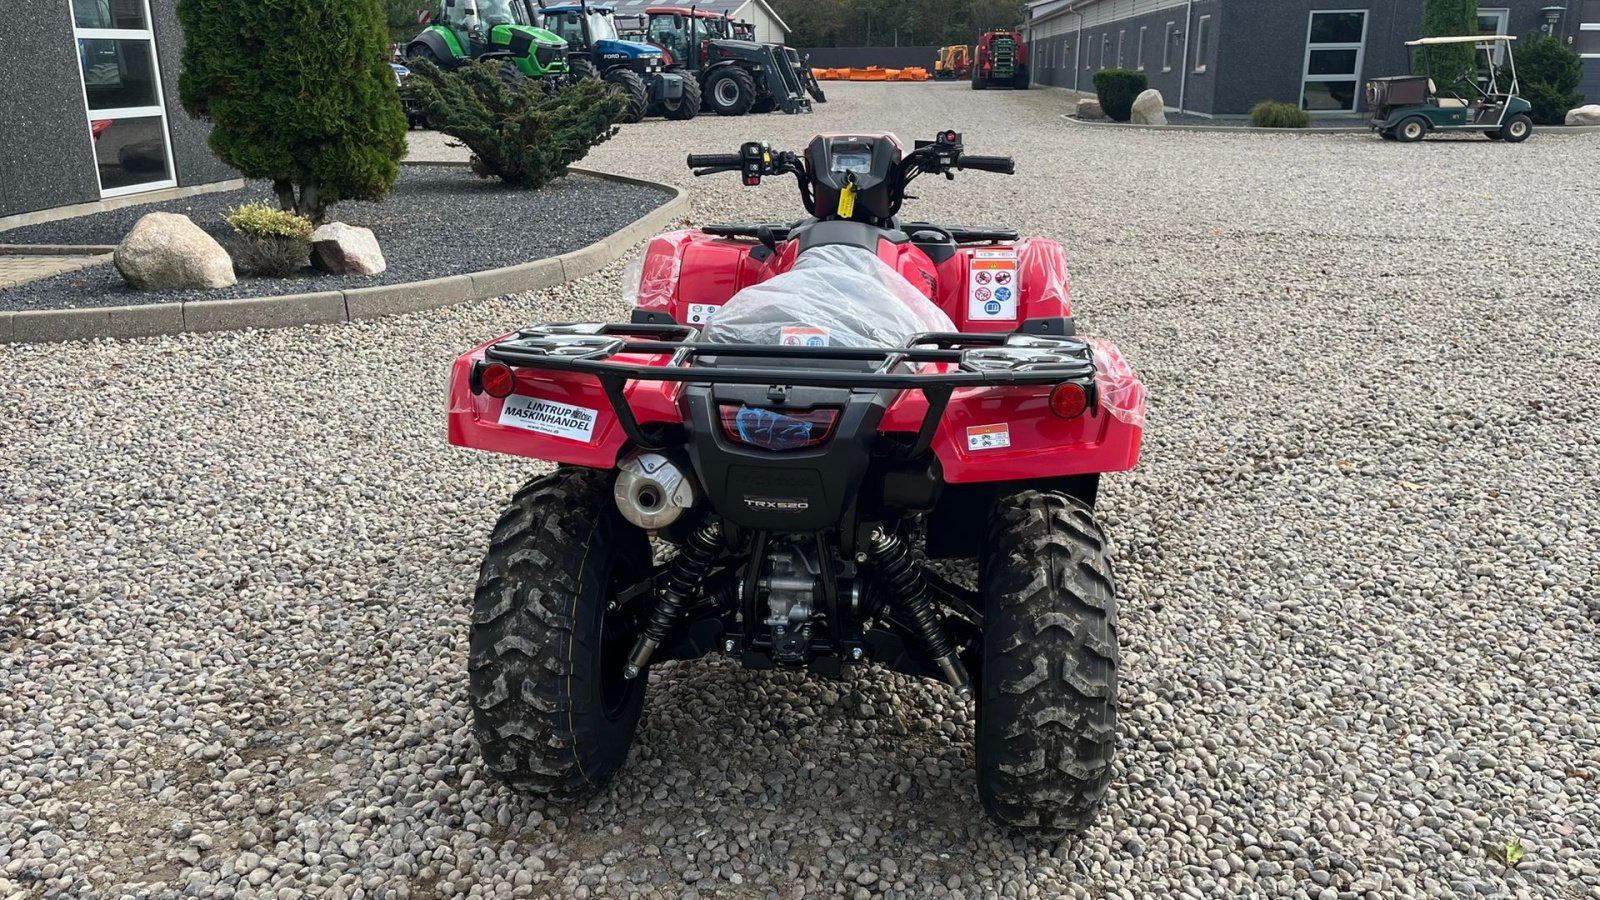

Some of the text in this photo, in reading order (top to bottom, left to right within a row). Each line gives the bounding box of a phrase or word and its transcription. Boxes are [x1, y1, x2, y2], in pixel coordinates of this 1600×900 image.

[527, 401, 572, 416] LINTRUP
[504, 407, 590, 431] MASKINHANDEL
[743, 499, 808, 509] TRX520
